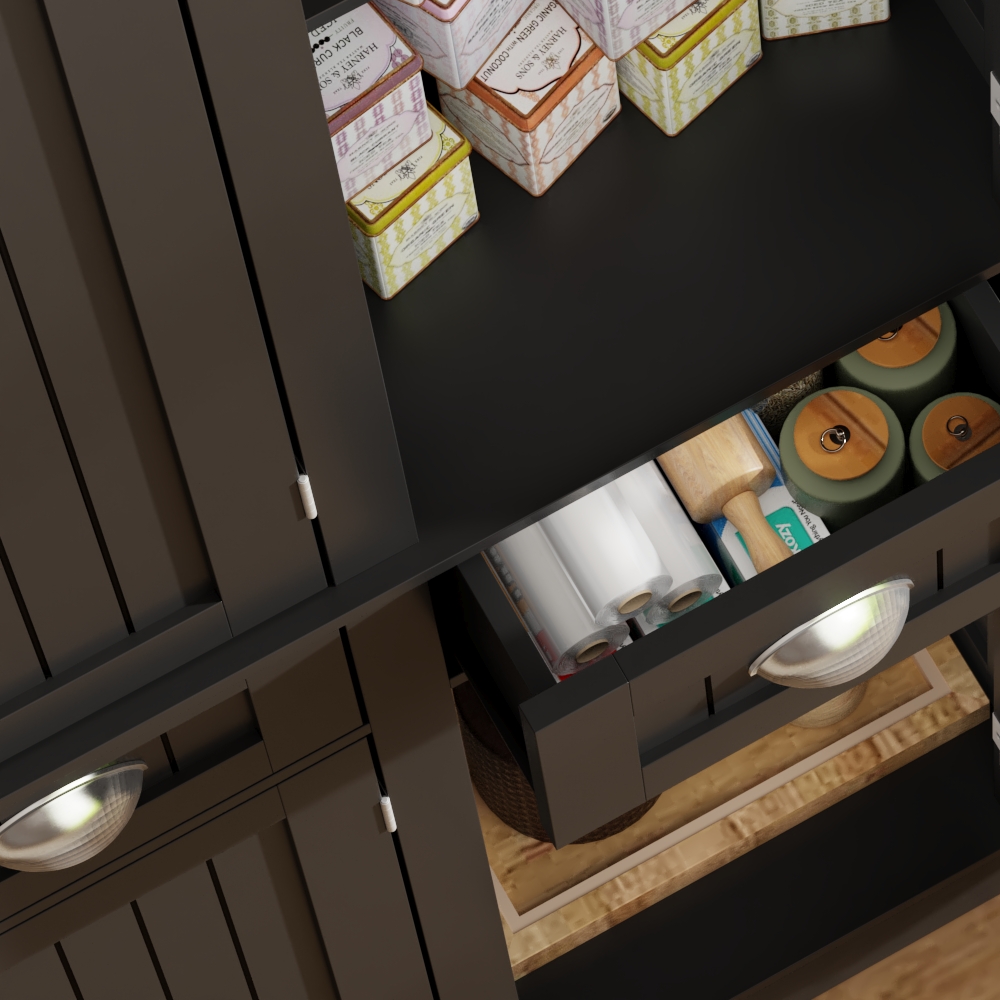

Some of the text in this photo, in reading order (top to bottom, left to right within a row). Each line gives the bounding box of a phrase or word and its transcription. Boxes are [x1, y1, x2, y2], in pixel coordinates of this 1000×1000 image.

[331, 25, 363, 52] BLACK
[515, 18, 539, 43] GREEN
[339, 41, 378, 73] HARNEY
[505, 38, 517, 52] WITH
[514, 25, 567, 80] HARNEY & SONS
[330, 69, 341, 79] &
[478, 49, 510, 82] COCONUT
